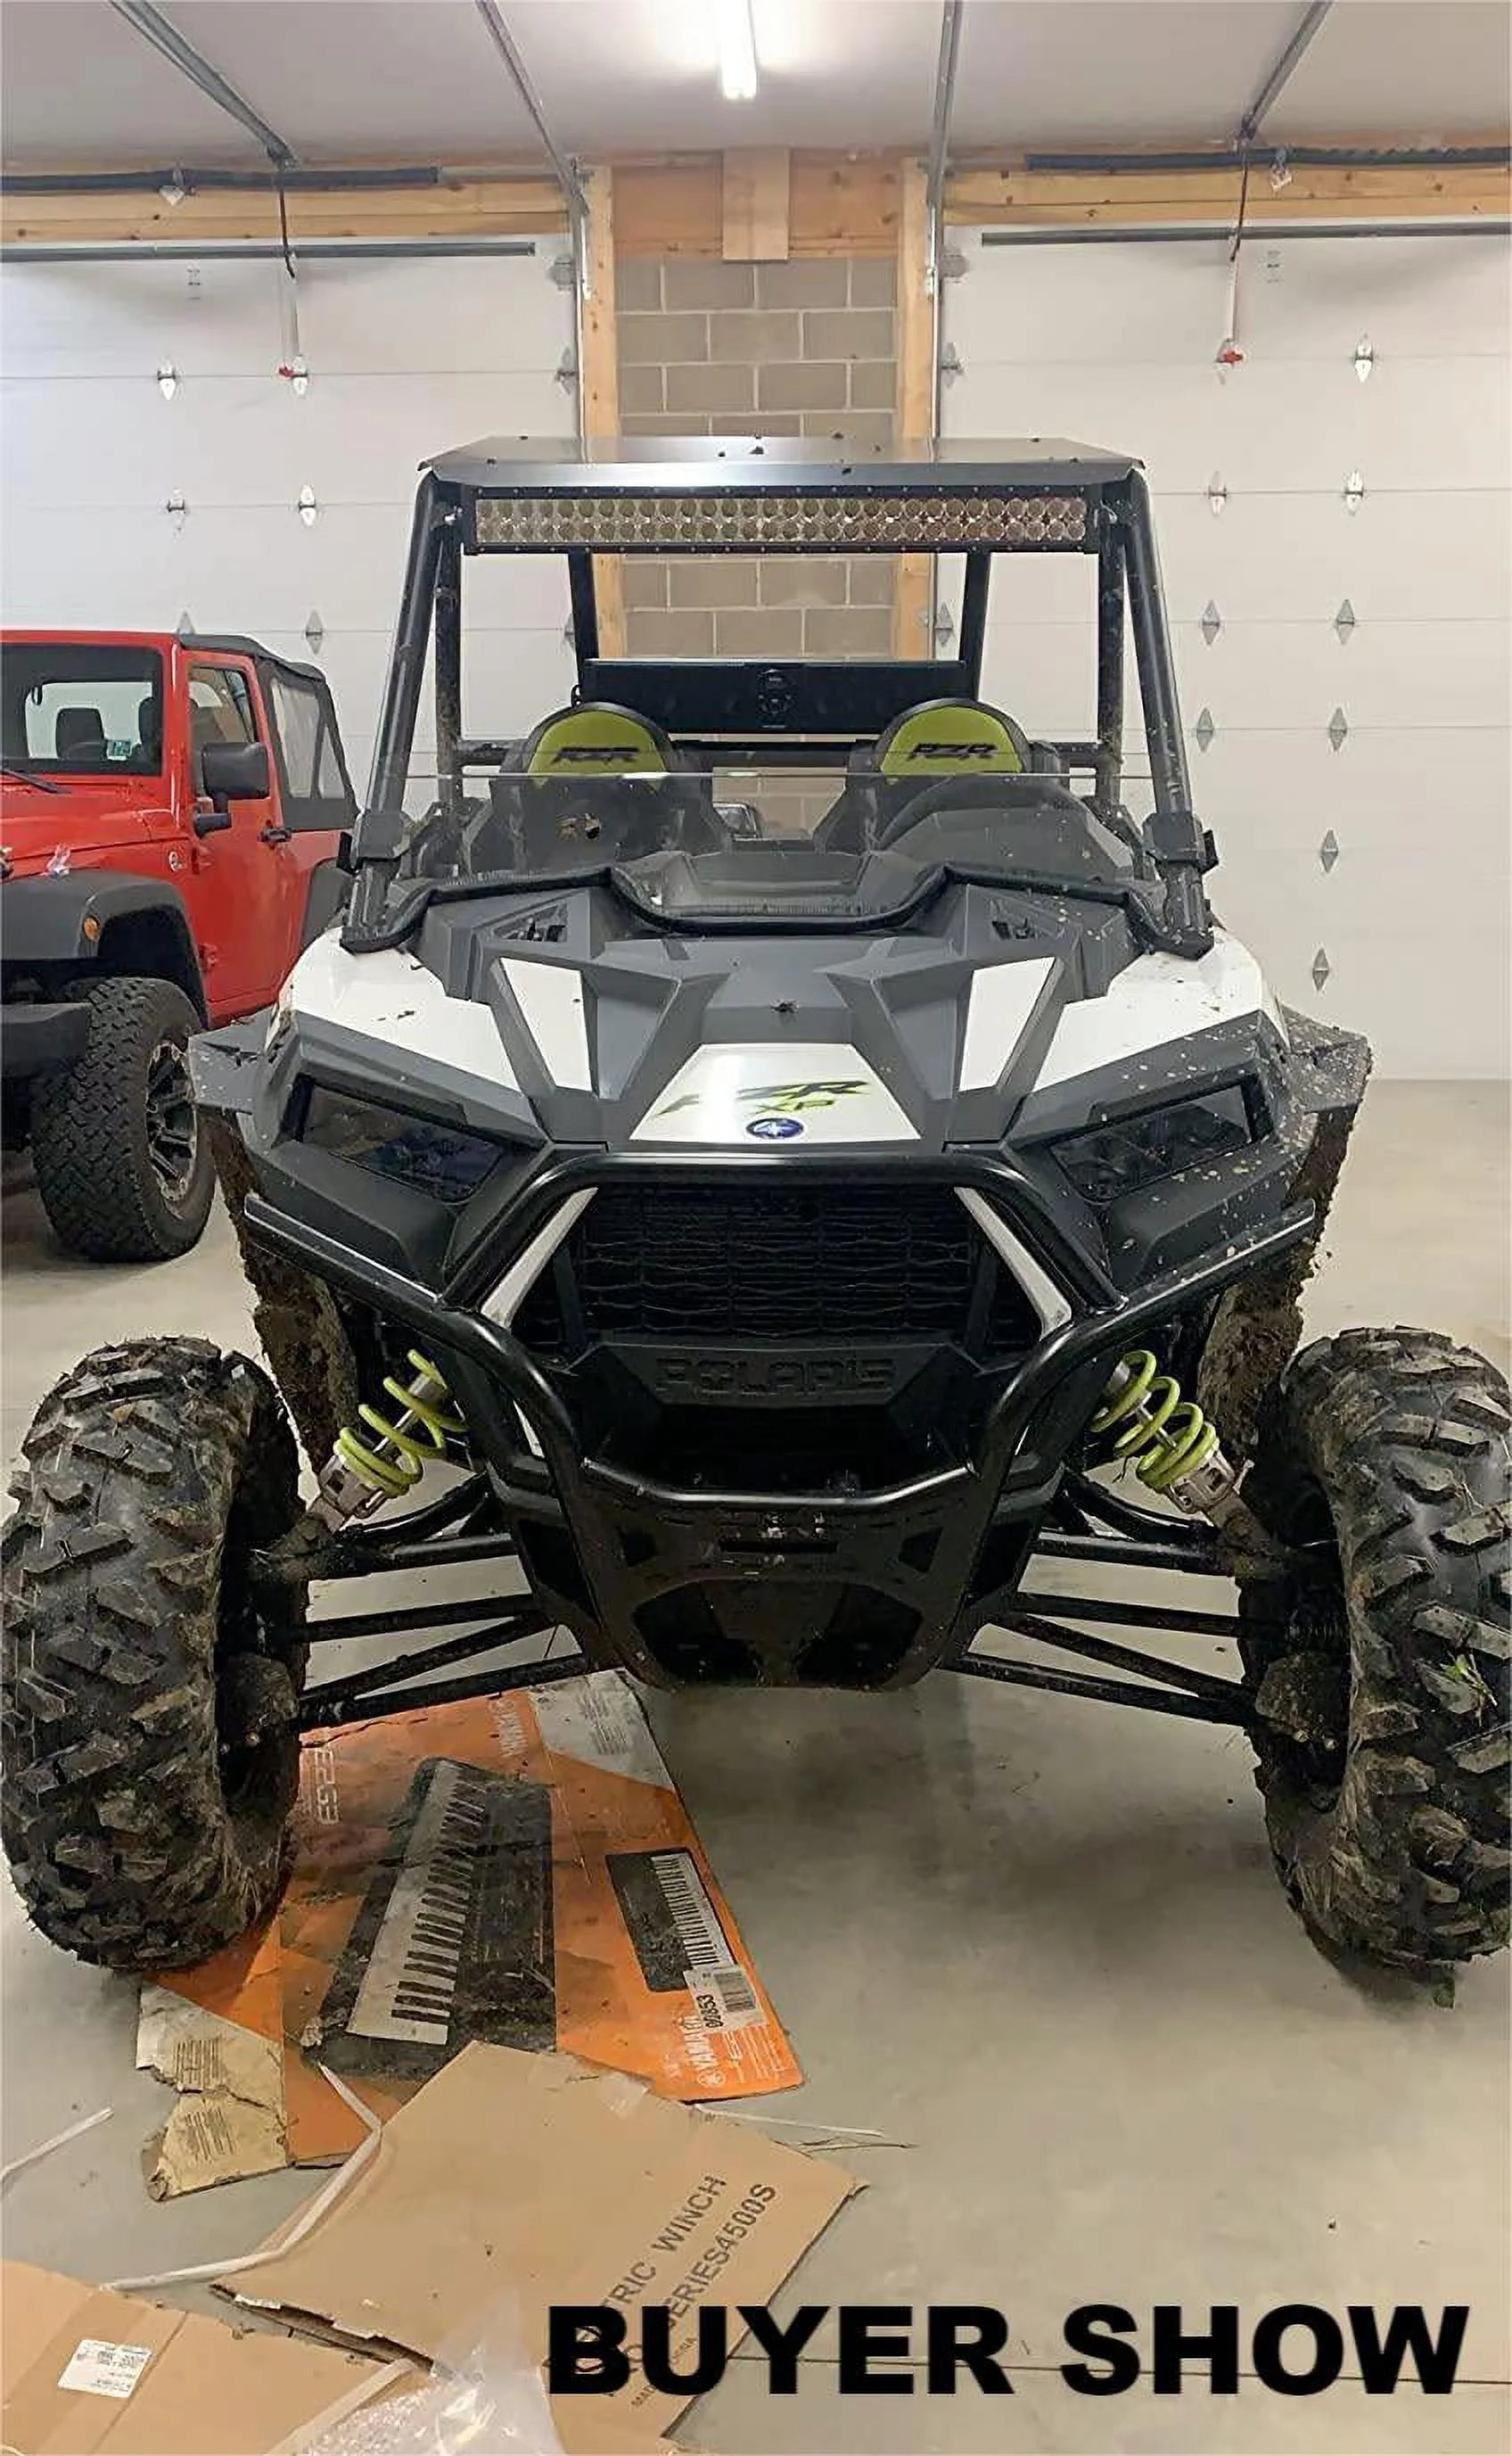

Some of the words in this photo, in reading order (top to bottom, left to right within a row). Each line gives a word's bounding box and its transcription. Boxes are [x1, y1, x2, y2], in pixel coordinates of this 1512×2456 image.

[908, 743, 998, 761] RZR
[655, 1357, 895, 1397] POLARIS
[651, 2175, 727, 2253] WINCH
